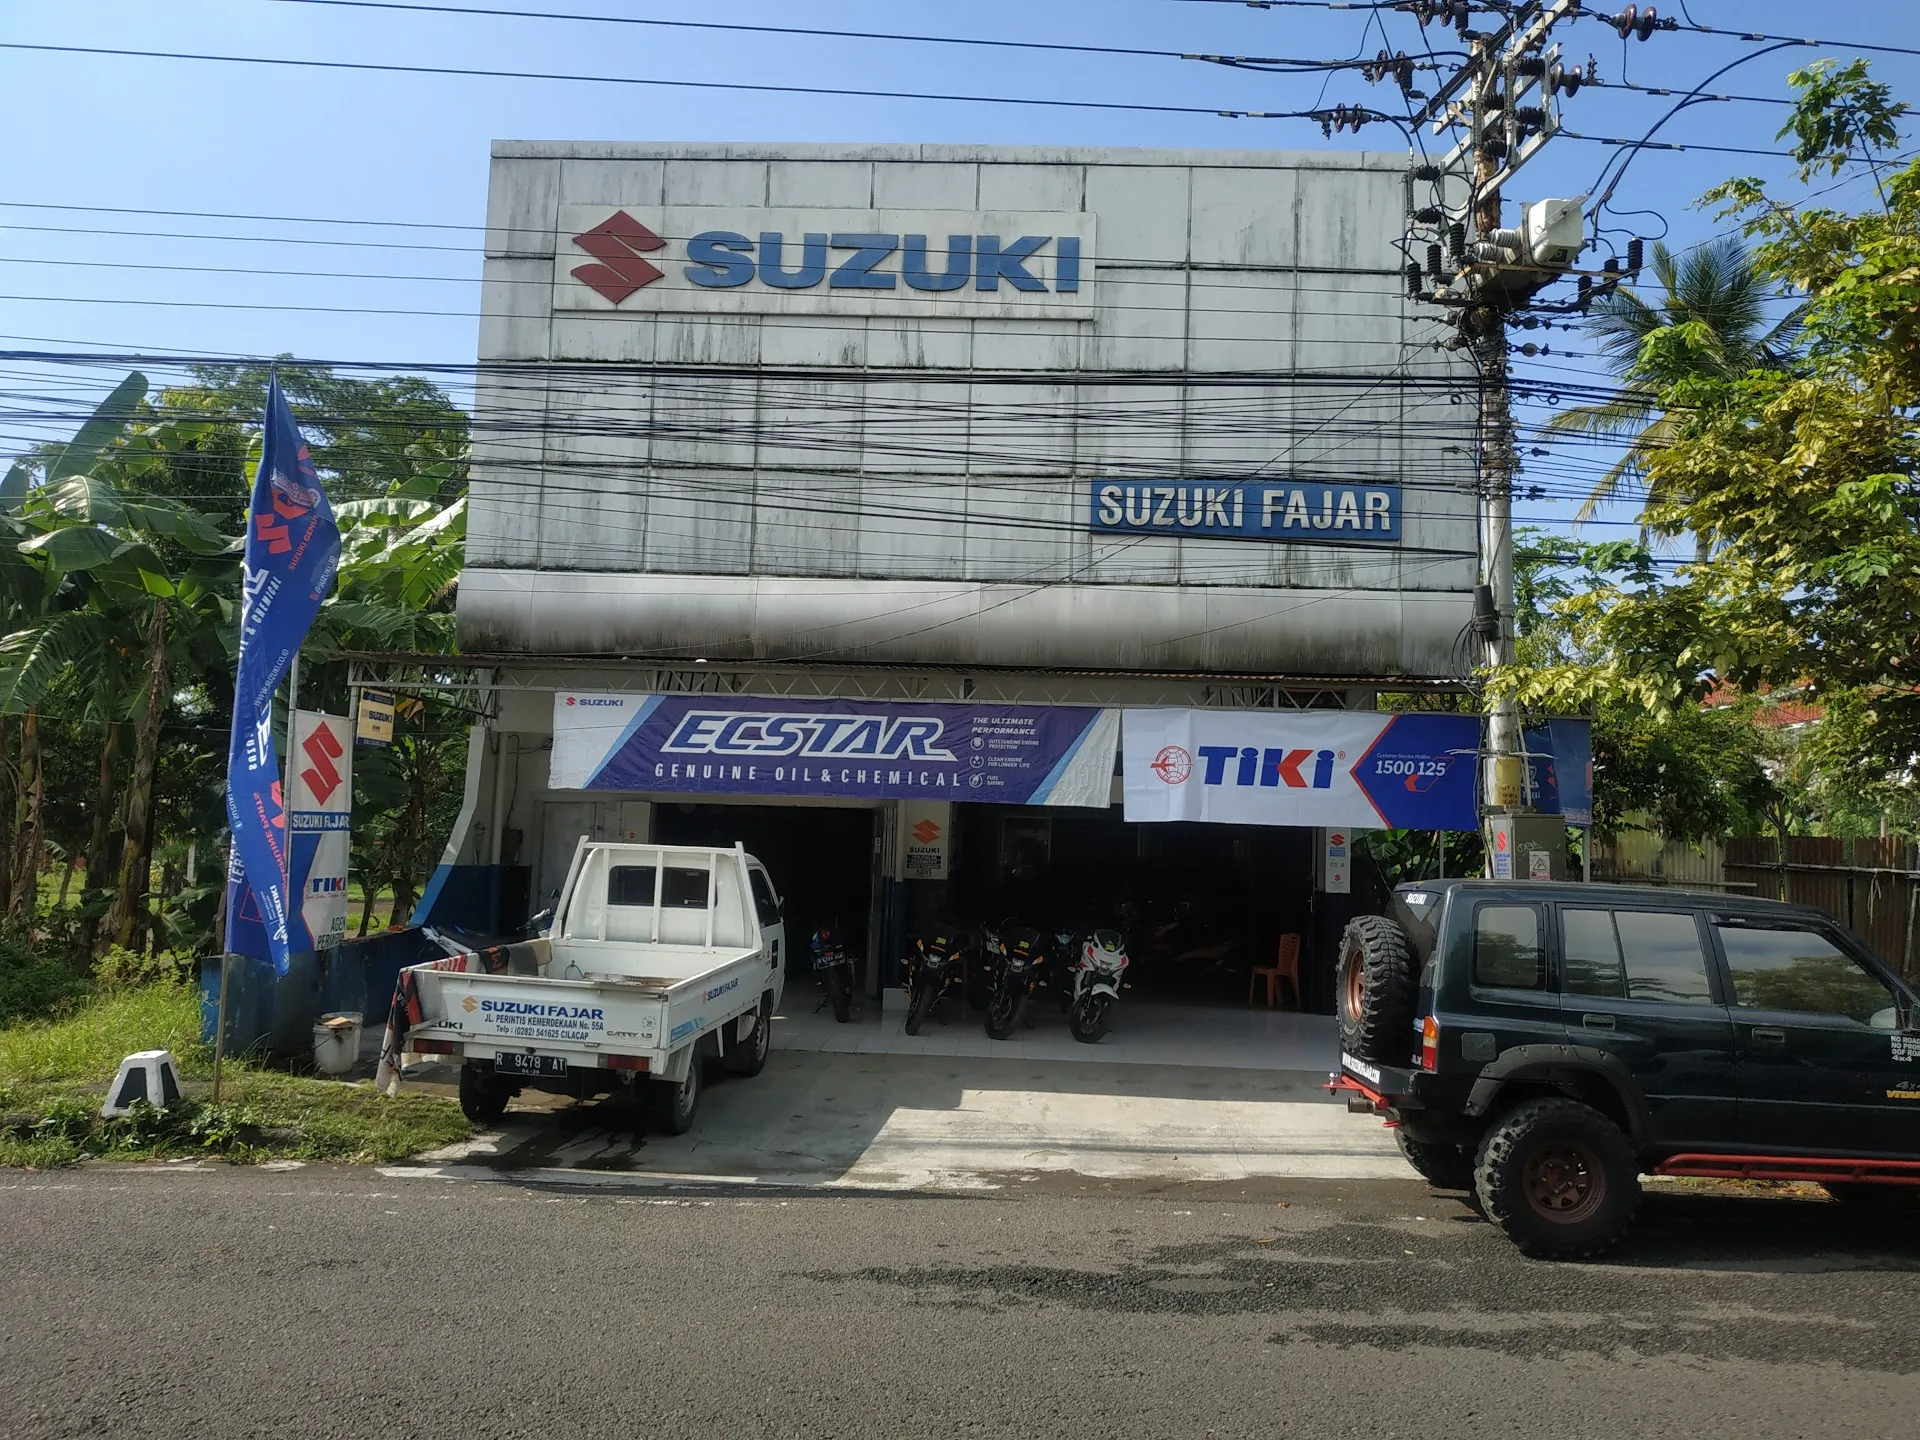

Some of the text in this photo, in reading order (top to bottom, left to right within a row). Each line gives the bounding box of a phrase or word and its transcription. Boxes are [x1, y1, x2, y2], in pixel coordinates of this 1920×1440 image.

[684, 230, 1080, 293] SUZUKI
[1098, 485, 1392, 531] SUZUKI FAJAR
[288, 541, 306, 571] SUZUKI
[252, 575, 282, 623] CHEMICAL
[579, 698, 624, 707] SUZUKI
[369, 711, 393, 723] SUZUKI
[991, 718, 1035, 726] ULTIMATE
[659, 710, 958, 762] ECSTAR
[971, 727, 1037, 735] PERFORMANCE
[655, 763, 756, 780] GENUINE
[841, 769, 961, 787] CHEMICAL
[1375, 760, 1447, 777] 1500 125
[293, 814, 322, 828] SUZUKI
[481, 1000, 605, 1020] SUZUKI FAJAR
[485, 1014, 604, 1031] JL. PERINTIS KEMERDEKAAN No. 55A
[496, 1025, 510, 1034] Telp
[514, 1026, 535, 1036] (0282)
[536, 1029, 559, 1038] 541625
[561, 1031, 589, 1040] CILACAP
[496, 1054, 565, 1071] R 9478 AT
[1892, 1054, 1912, 1062] 4x4
